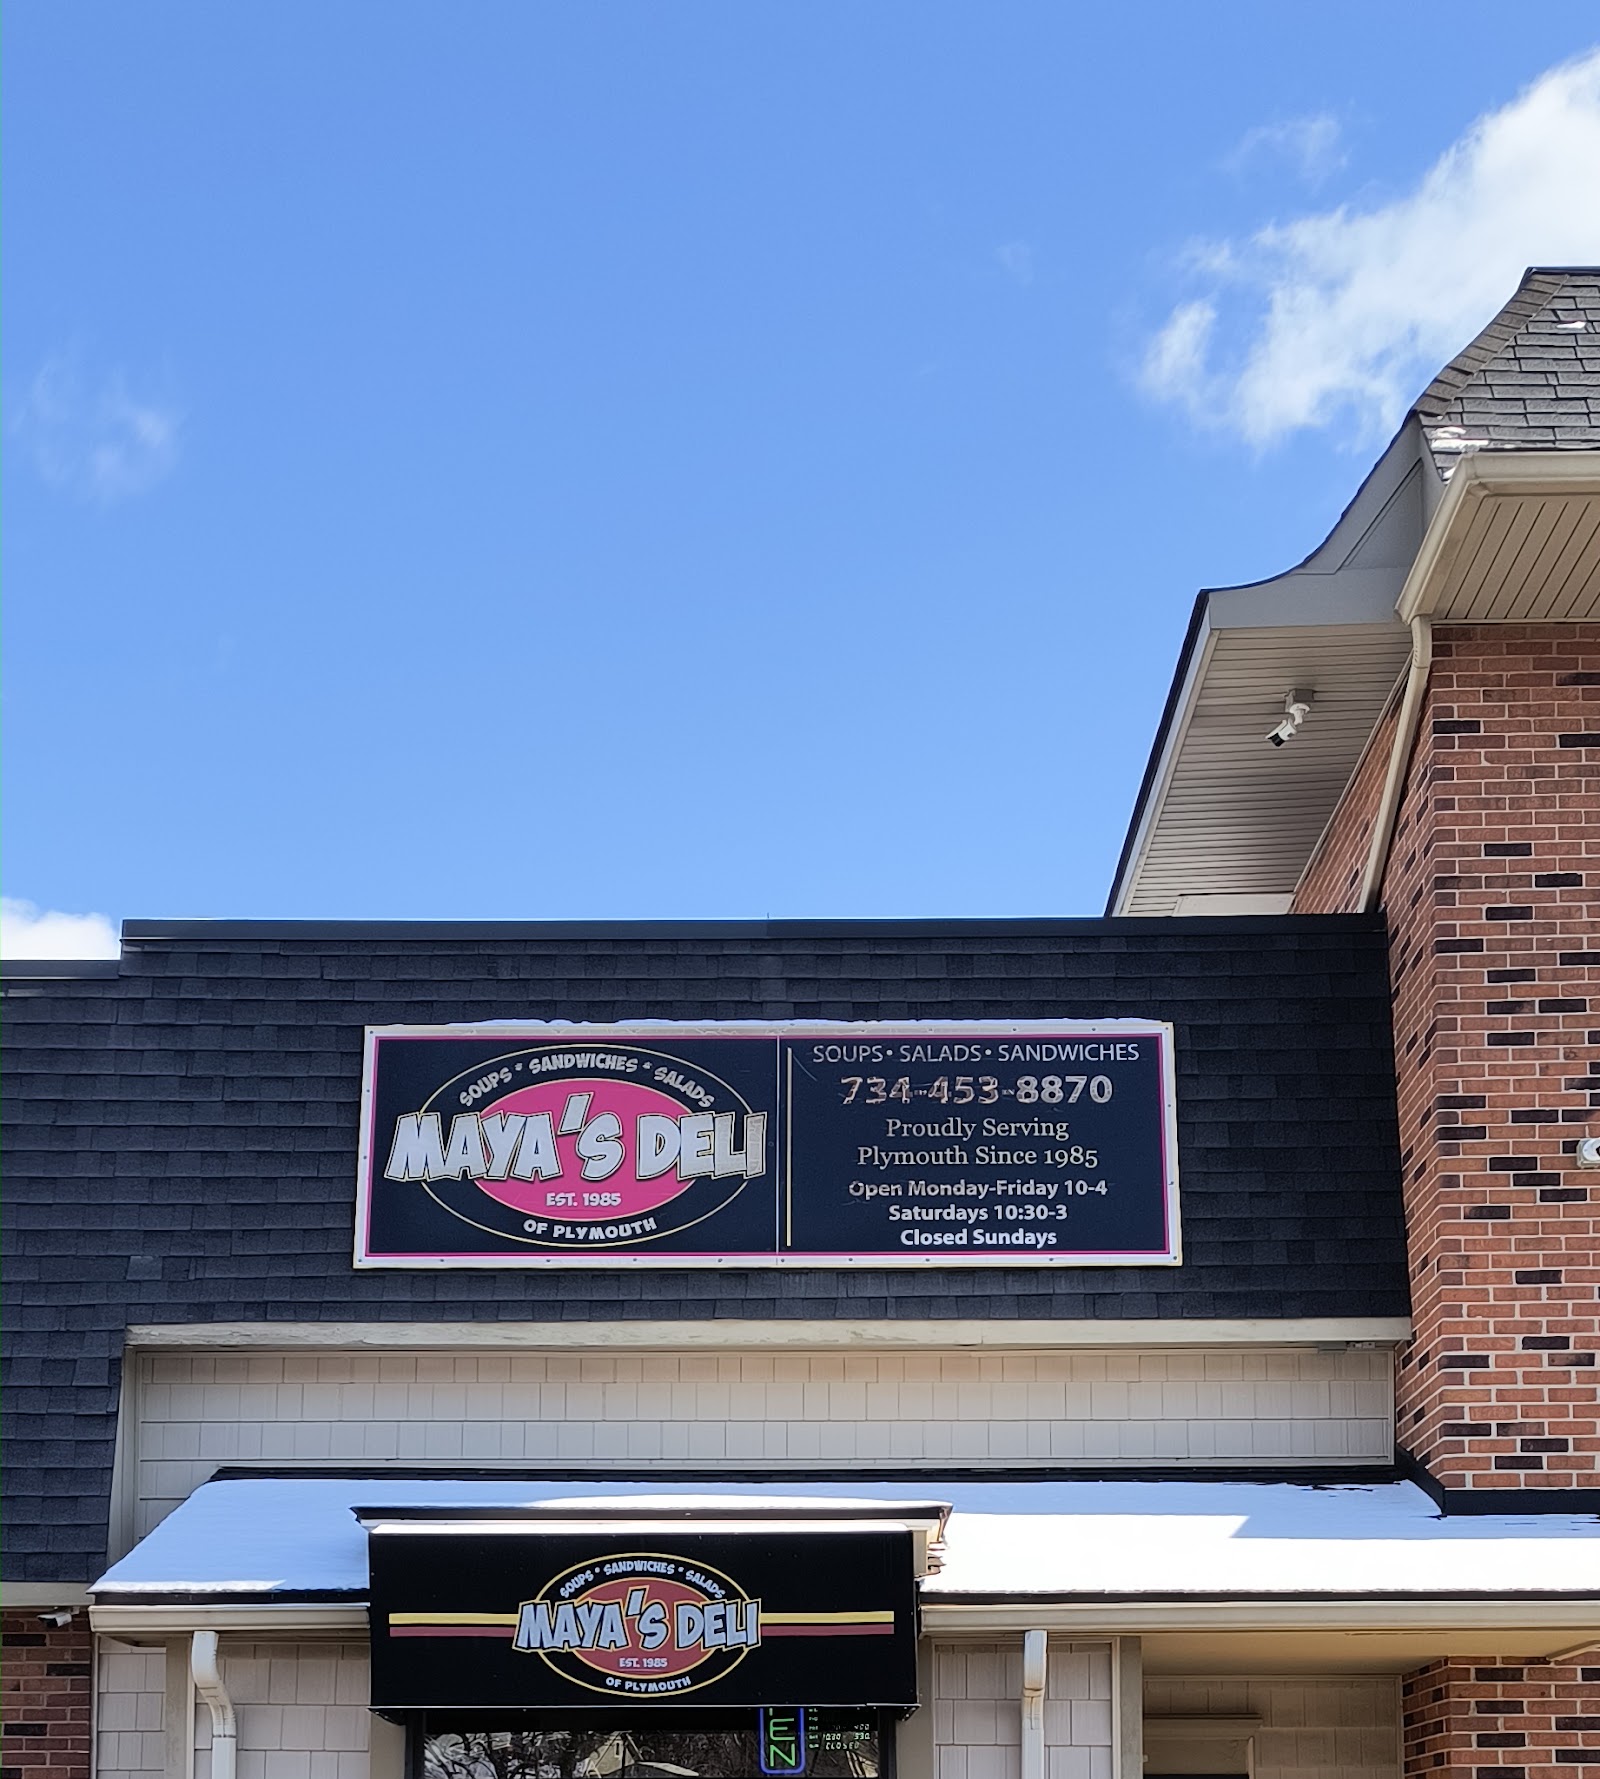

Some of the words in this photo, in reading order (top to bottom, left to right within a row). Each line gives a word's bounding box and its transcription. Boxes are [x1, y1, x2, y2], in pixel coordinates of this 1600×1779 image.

[998, 1043, 1140, 1062] SANDWICHES
[459, 1067, 512, 1107] SOUPS
[528, 1052, 638, 1075] SANDWICHES
[653, 1067, 715, 1108] SALADS
[840, 1075, 1114, 1105] 734-453-8870
[384, 1091, 626, 1182] MAYA'S
[635, 1111, 767, 1181] DELI
[886, 1118, 977, 1141] Proudly
[982, 1117, 1070, 1141] Serving
[857, 1146, 969, 1170] Plymouth
[975, 1146, 1037, 1165] Since
[1044, 1146, 1098, 1169] 1985
[545, 1192, 579, 1207] EST.
[583, 1191, 622, 1206] 1985
[848, 1180, 903, 1201] Open
[908, 1179, 1059, 1199] Monday-Friday
[1064, 1179, 1108, 1196] 10-4
[888, 1204, 989, 1226] Saturdays
[993, 1204, 1068, 1221] 10:30-3
[523, 1218, 548, 1235] OF
[552, 1216, 657, 1240] PLYMOUTH
[900, 1228, 968, 1247] Closed
[973, 1228, 1057, 1249] Sundays
[559, 1569, 595, 1599] SOUPS
[603, 1560, 675, 1576] SANDWICHES
[685, 1569, 726, 1599] SALADS
[512, 1585, 670, 1653] MAYA'S
[675, 1598, 762, 1651] DELI
[619, 1657, 641, 1668] EST.
[642, 1657, 668, 1668] 1985
[605, 1676, 622, 1687] OF
[624, 1675, 692, 1693] PLYMOUTH
